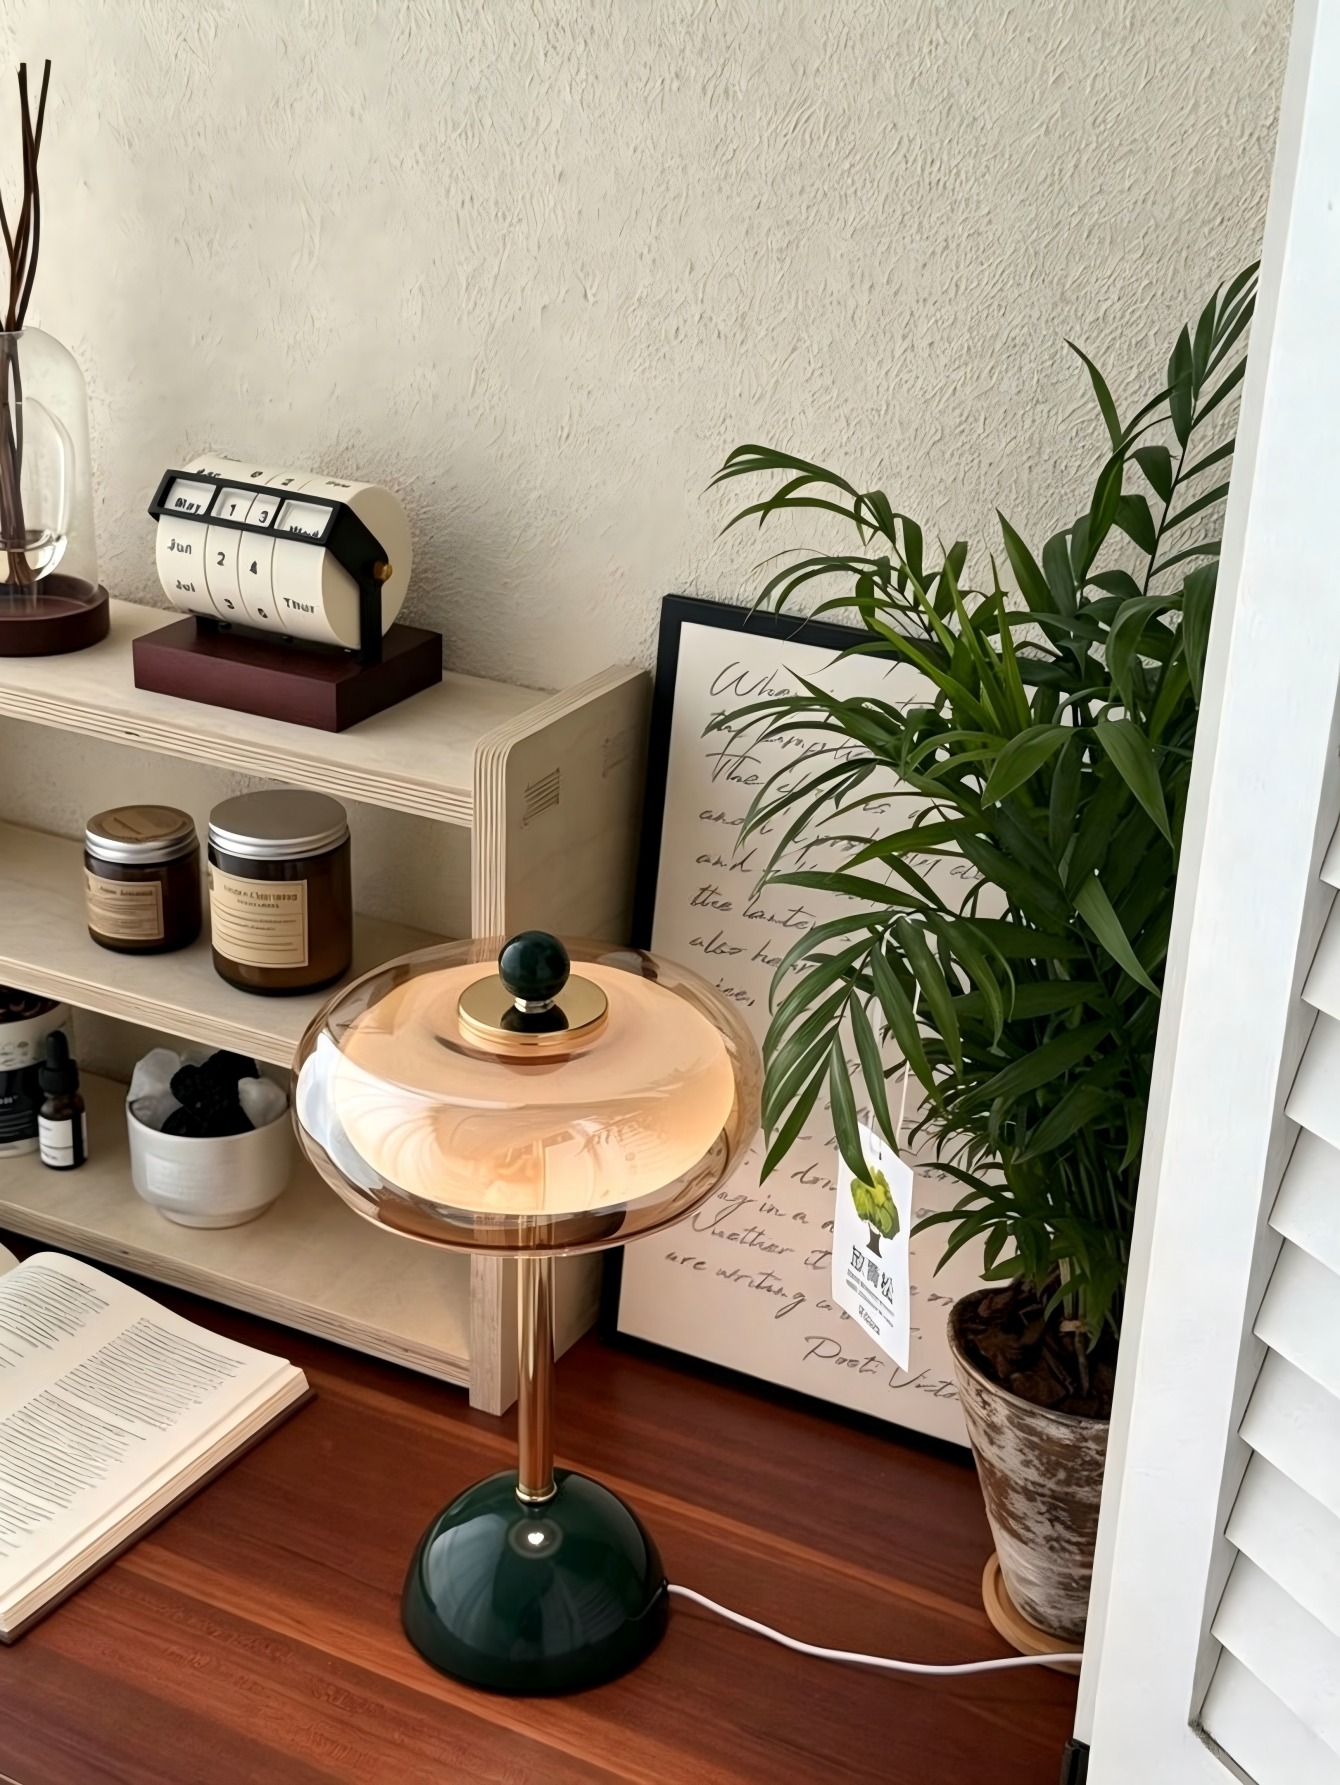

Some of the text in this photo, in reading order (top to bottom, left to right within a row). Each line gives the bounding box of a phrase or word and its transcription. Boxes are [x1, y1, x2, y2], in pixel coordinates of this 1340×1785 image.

[229, 503, 237, 517] 1
[258, 510, 269, 524] 3
[167, 538, 258, 575] Jun 2 4
[176, 579, 196, 593] Jul
